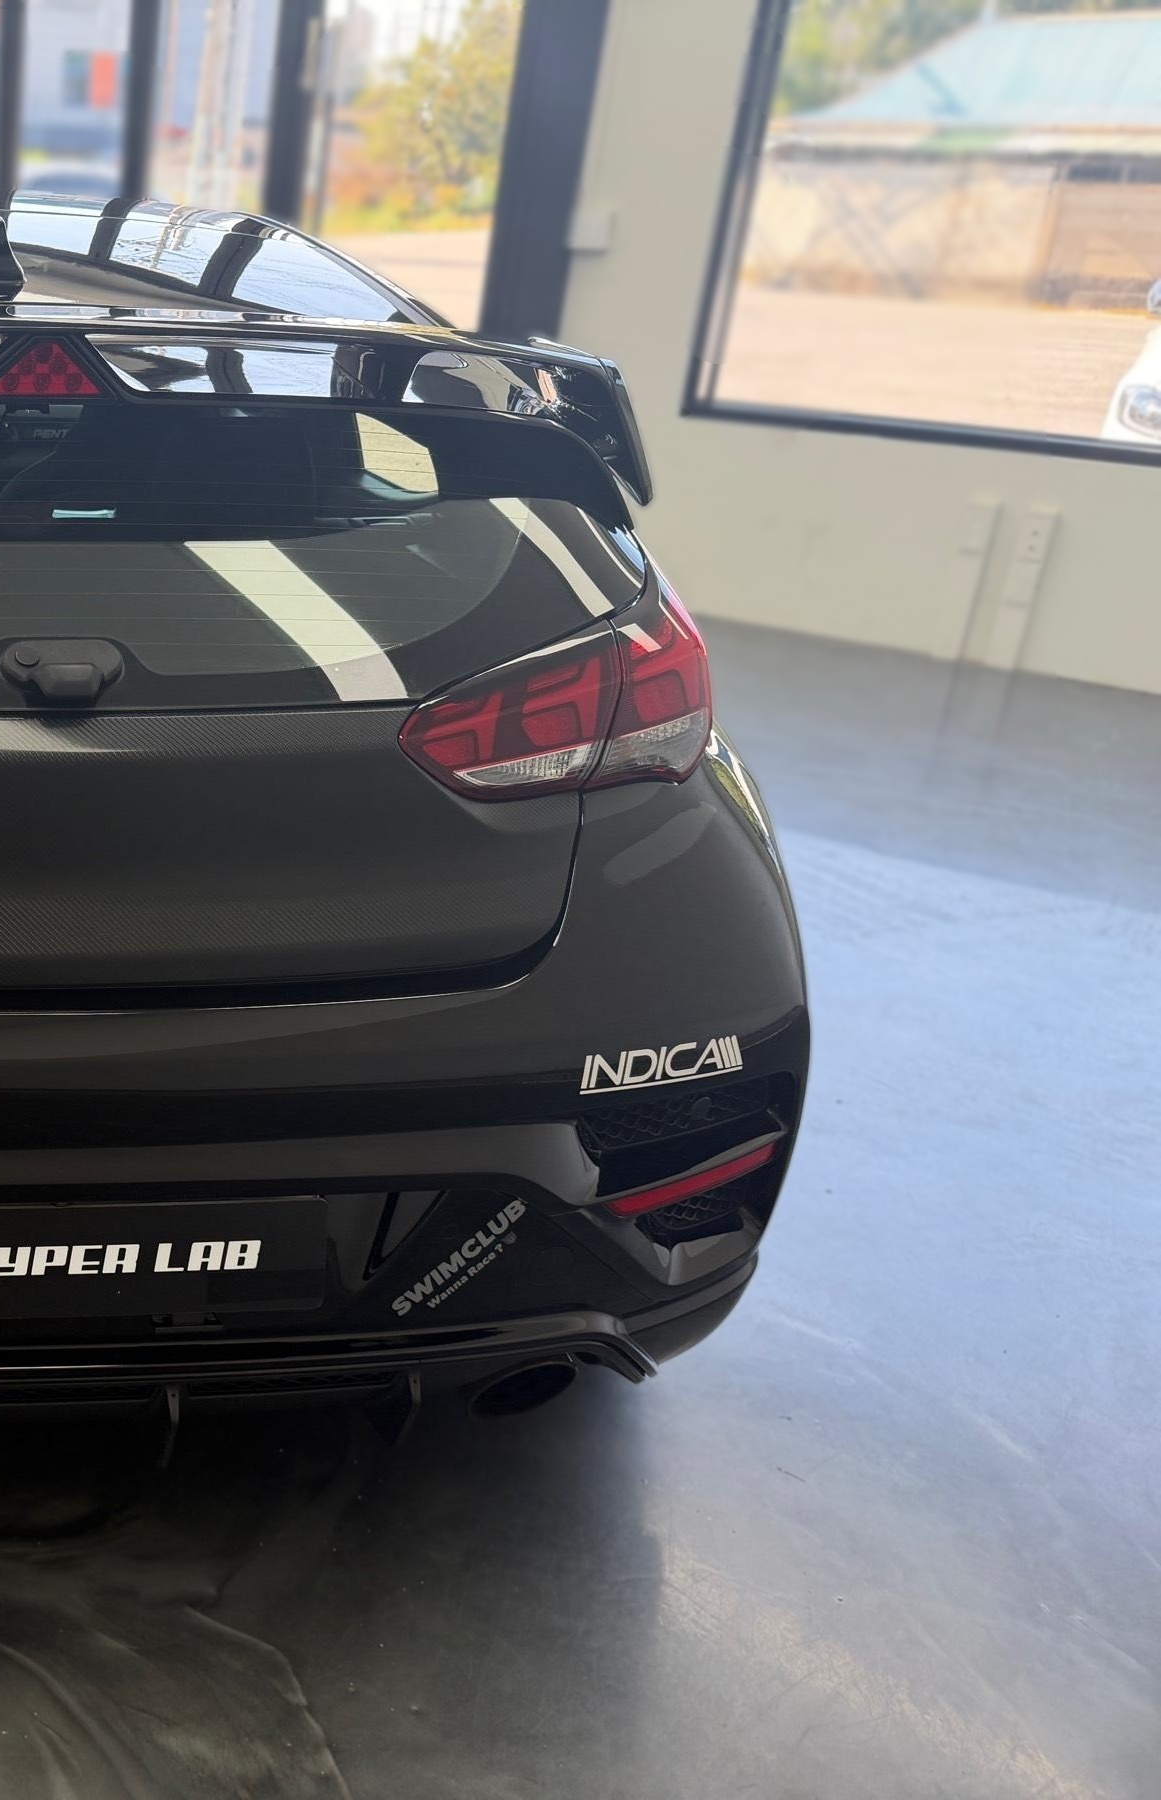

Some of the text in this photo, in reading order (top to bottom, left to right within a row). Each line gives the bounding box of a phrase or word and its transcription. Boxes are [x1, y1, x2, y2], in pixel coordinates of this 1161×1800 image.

[153, 1239, 261, 1273] LAB
[391, 1199, 527, 1317] SWIMCLUB
[426, 1275, 469, 1309] Wanna
[466, 1252, 497, 1277] Race
